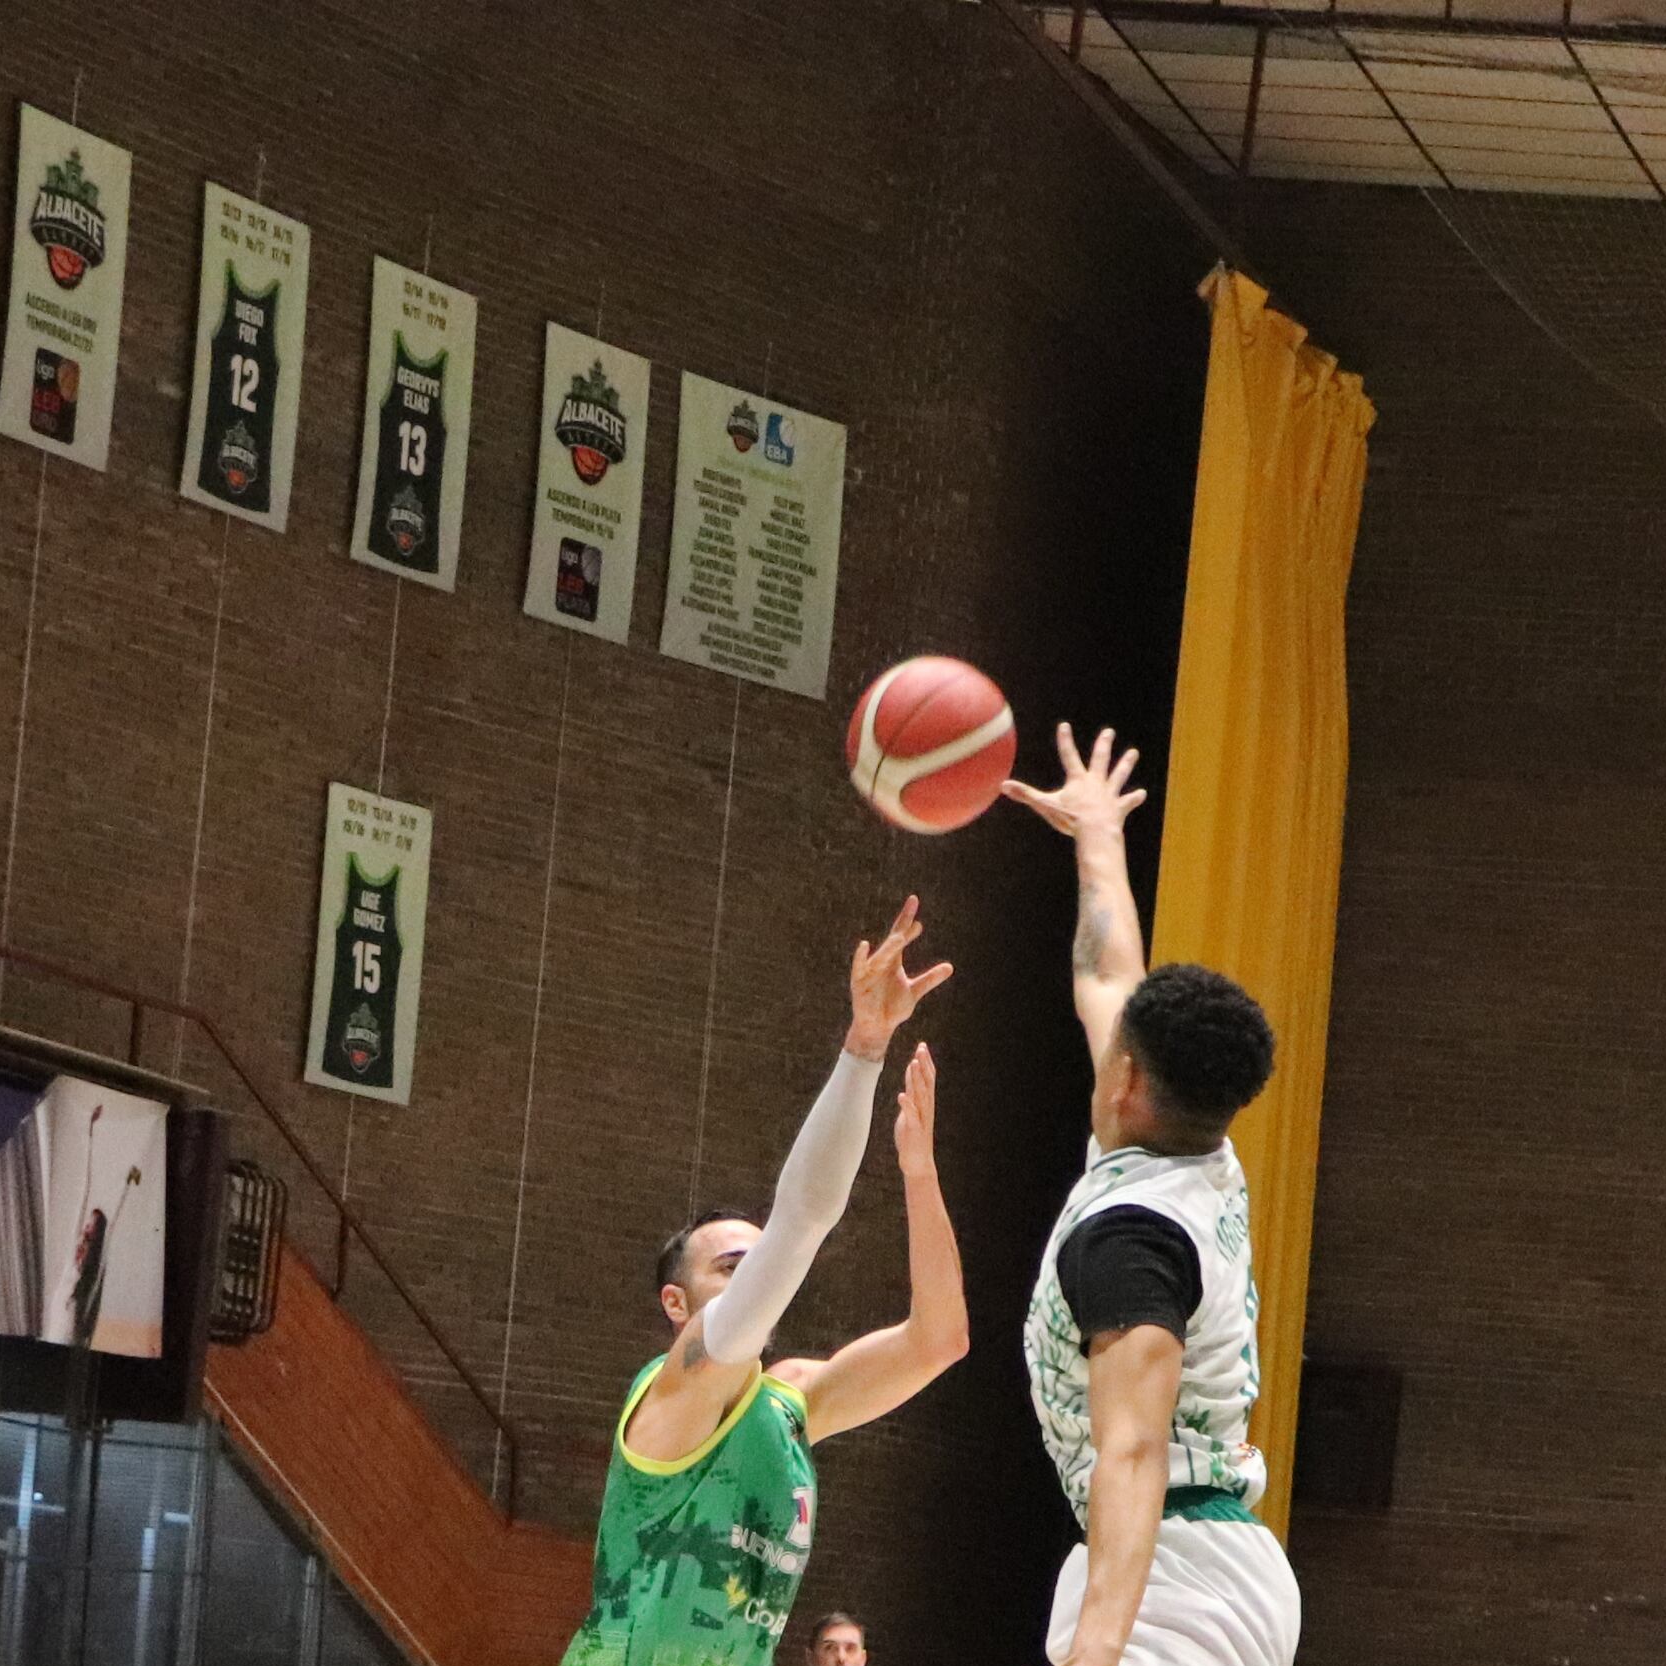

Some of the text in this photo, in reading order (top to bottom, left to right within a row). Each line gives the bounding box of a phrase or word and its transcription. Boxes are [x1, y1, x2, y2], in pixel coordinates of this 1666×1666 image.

[36, 191, 104, 247] ALBACETE
[231, 354, 259, 413] 12
[399, 420, 427, 476] 13
[561, 399, 624, 444] ALBACETE
[352, 940, 382, 994] 15
